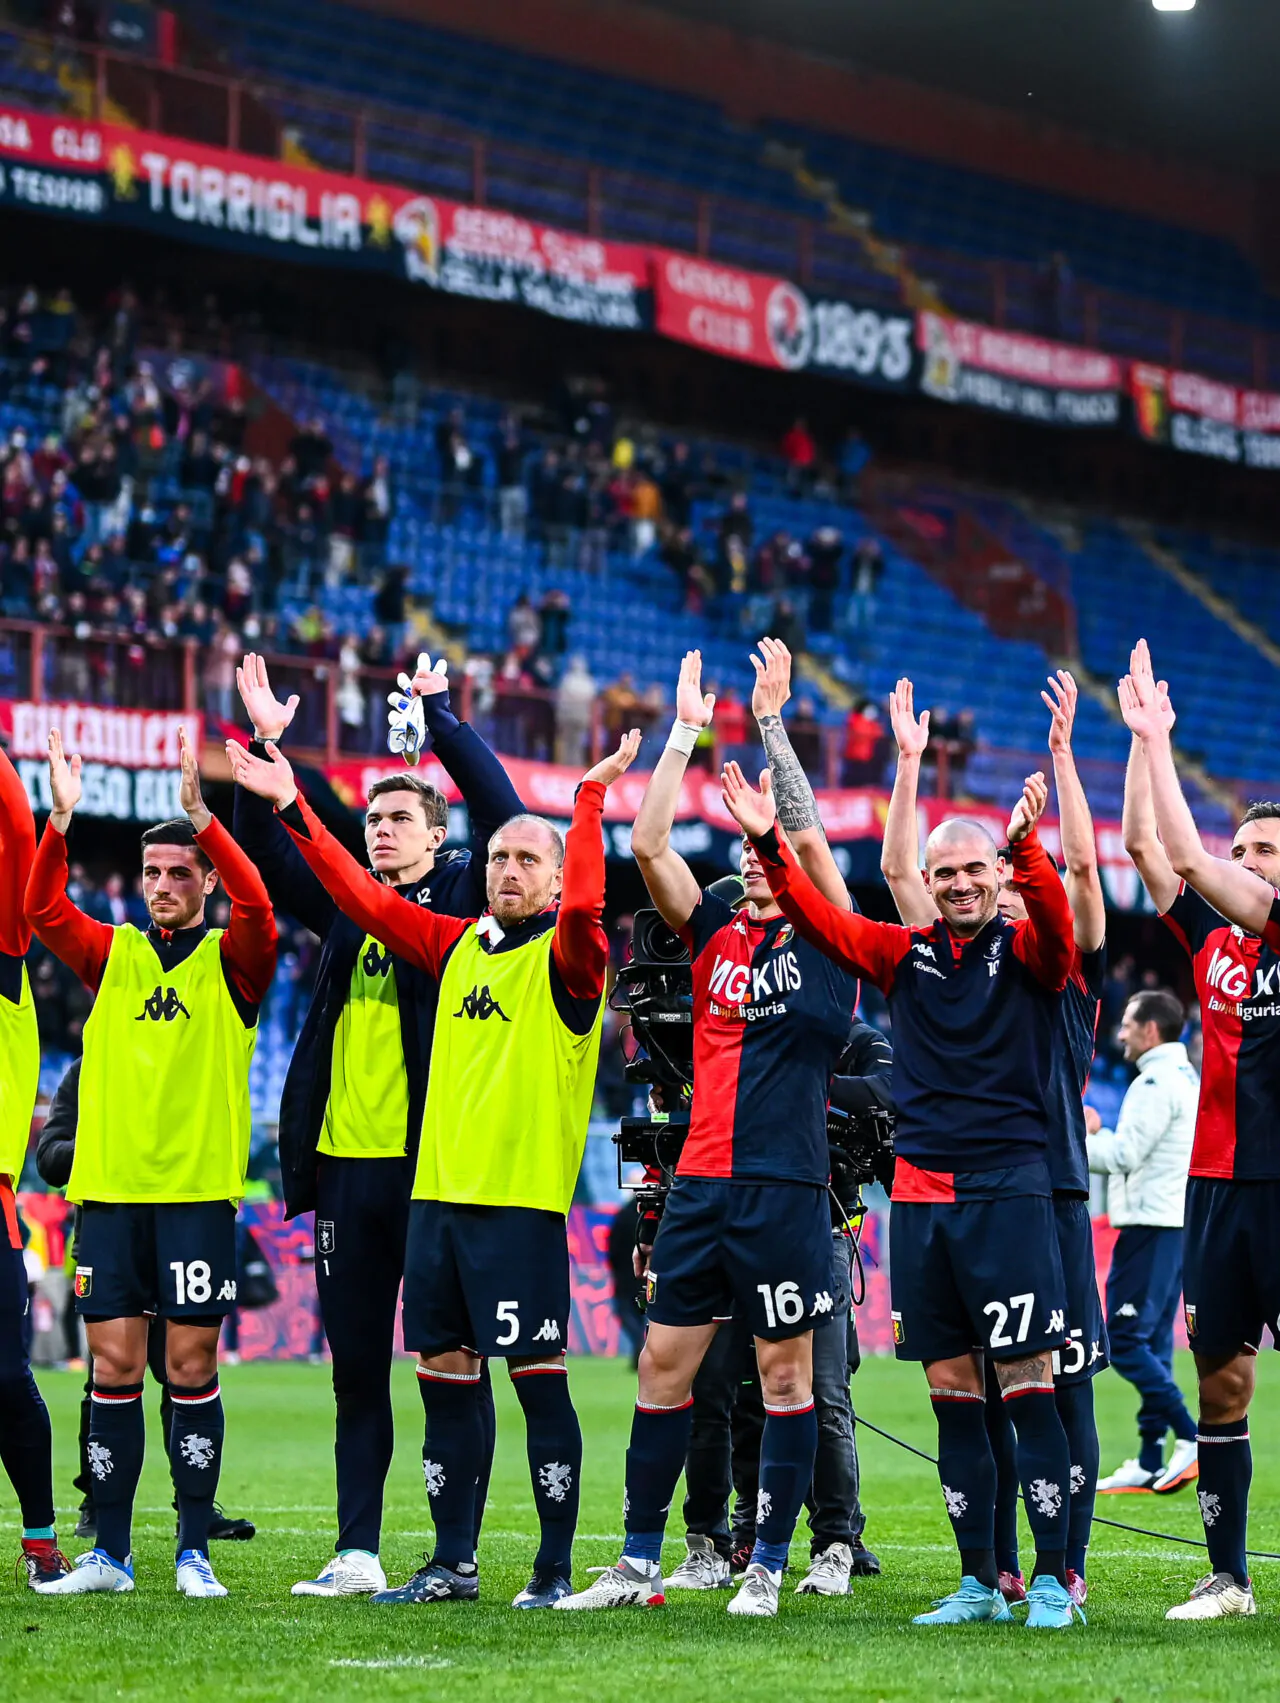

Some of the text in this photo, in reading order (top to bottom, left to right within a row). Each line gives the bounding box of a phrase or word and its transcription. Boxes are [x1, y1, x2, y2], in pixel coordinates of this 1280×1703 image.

[141, 152, 363, 250] TORRIGLIA
[814, 301, 912, 382] 1893
[169, 1260, 212, 1305] 18
[757, 1281, 804, 1328] 16
[495, 1300, 520, 1346] 5
[983, 1292, 1035, 1348] 27
